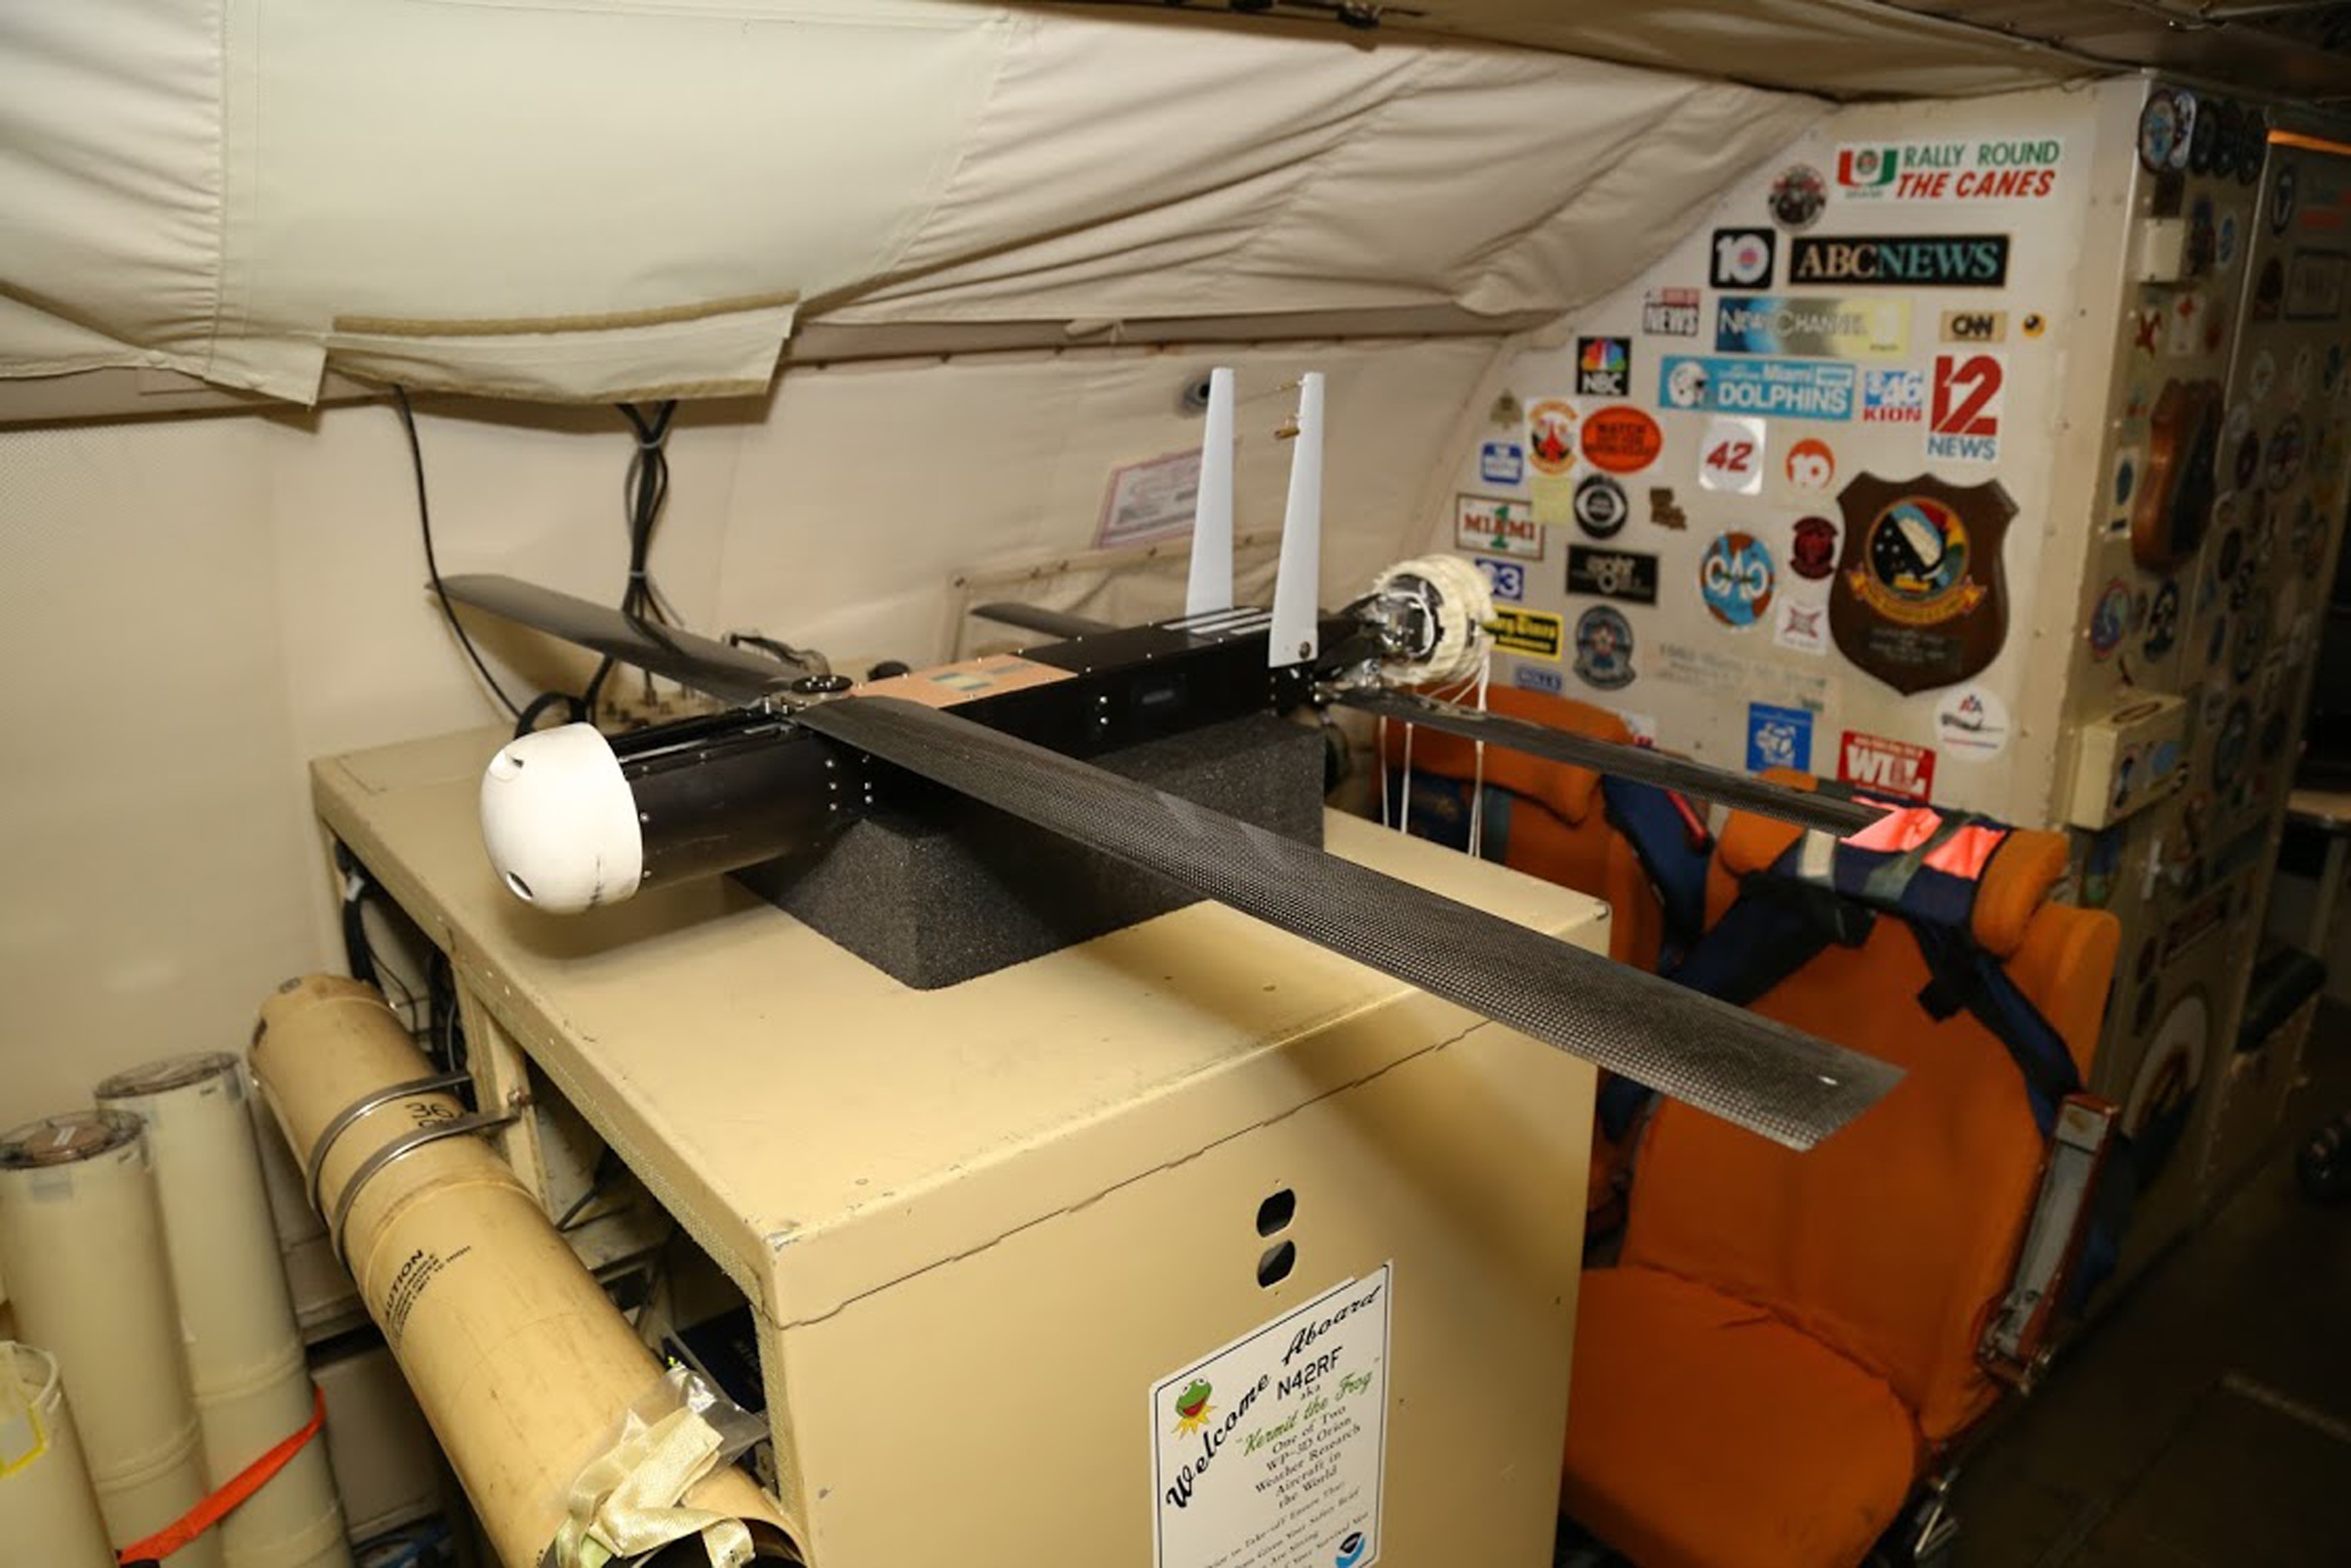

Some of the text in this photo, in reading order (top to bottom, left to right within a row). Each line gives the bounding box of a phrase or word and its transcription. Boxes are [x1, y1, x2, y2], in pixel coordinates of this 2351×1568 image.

[1904, 139, 2060, 169] RALLY ROUND
[1896, 168, 2056, 199] THE CANES
[1715, 234, 1769, 284] 10
[1951, 314, 1995, 337] CNN
[1717, 381, 1848, 414] DOLPHINS
[1929, 354, 2002, 436] 12
[1863, 407, 1922, 422] KION
[1706, 440, 1753, 472] 42
[1927, 436, 1997, 461] NEWS
[1464, 512, 1535, 541] MIAMI
[385, 1248, 423, 1326] AUTION
[1277, 1345, 1343, 1401] N42RF
[1166, 1284, 1382, 1509] Welcome Aboard
[1303, 1395, 1329, 1421] the
[1272, 1434, 1298, 1454] One
[1320, 1405, 1346, 1425] Two
[1255, 1459, 1305, 1493] Weather
[1275, 1451, 1342, 1497] Aircraft in
[1302, 1465, 1338, 1492] World
